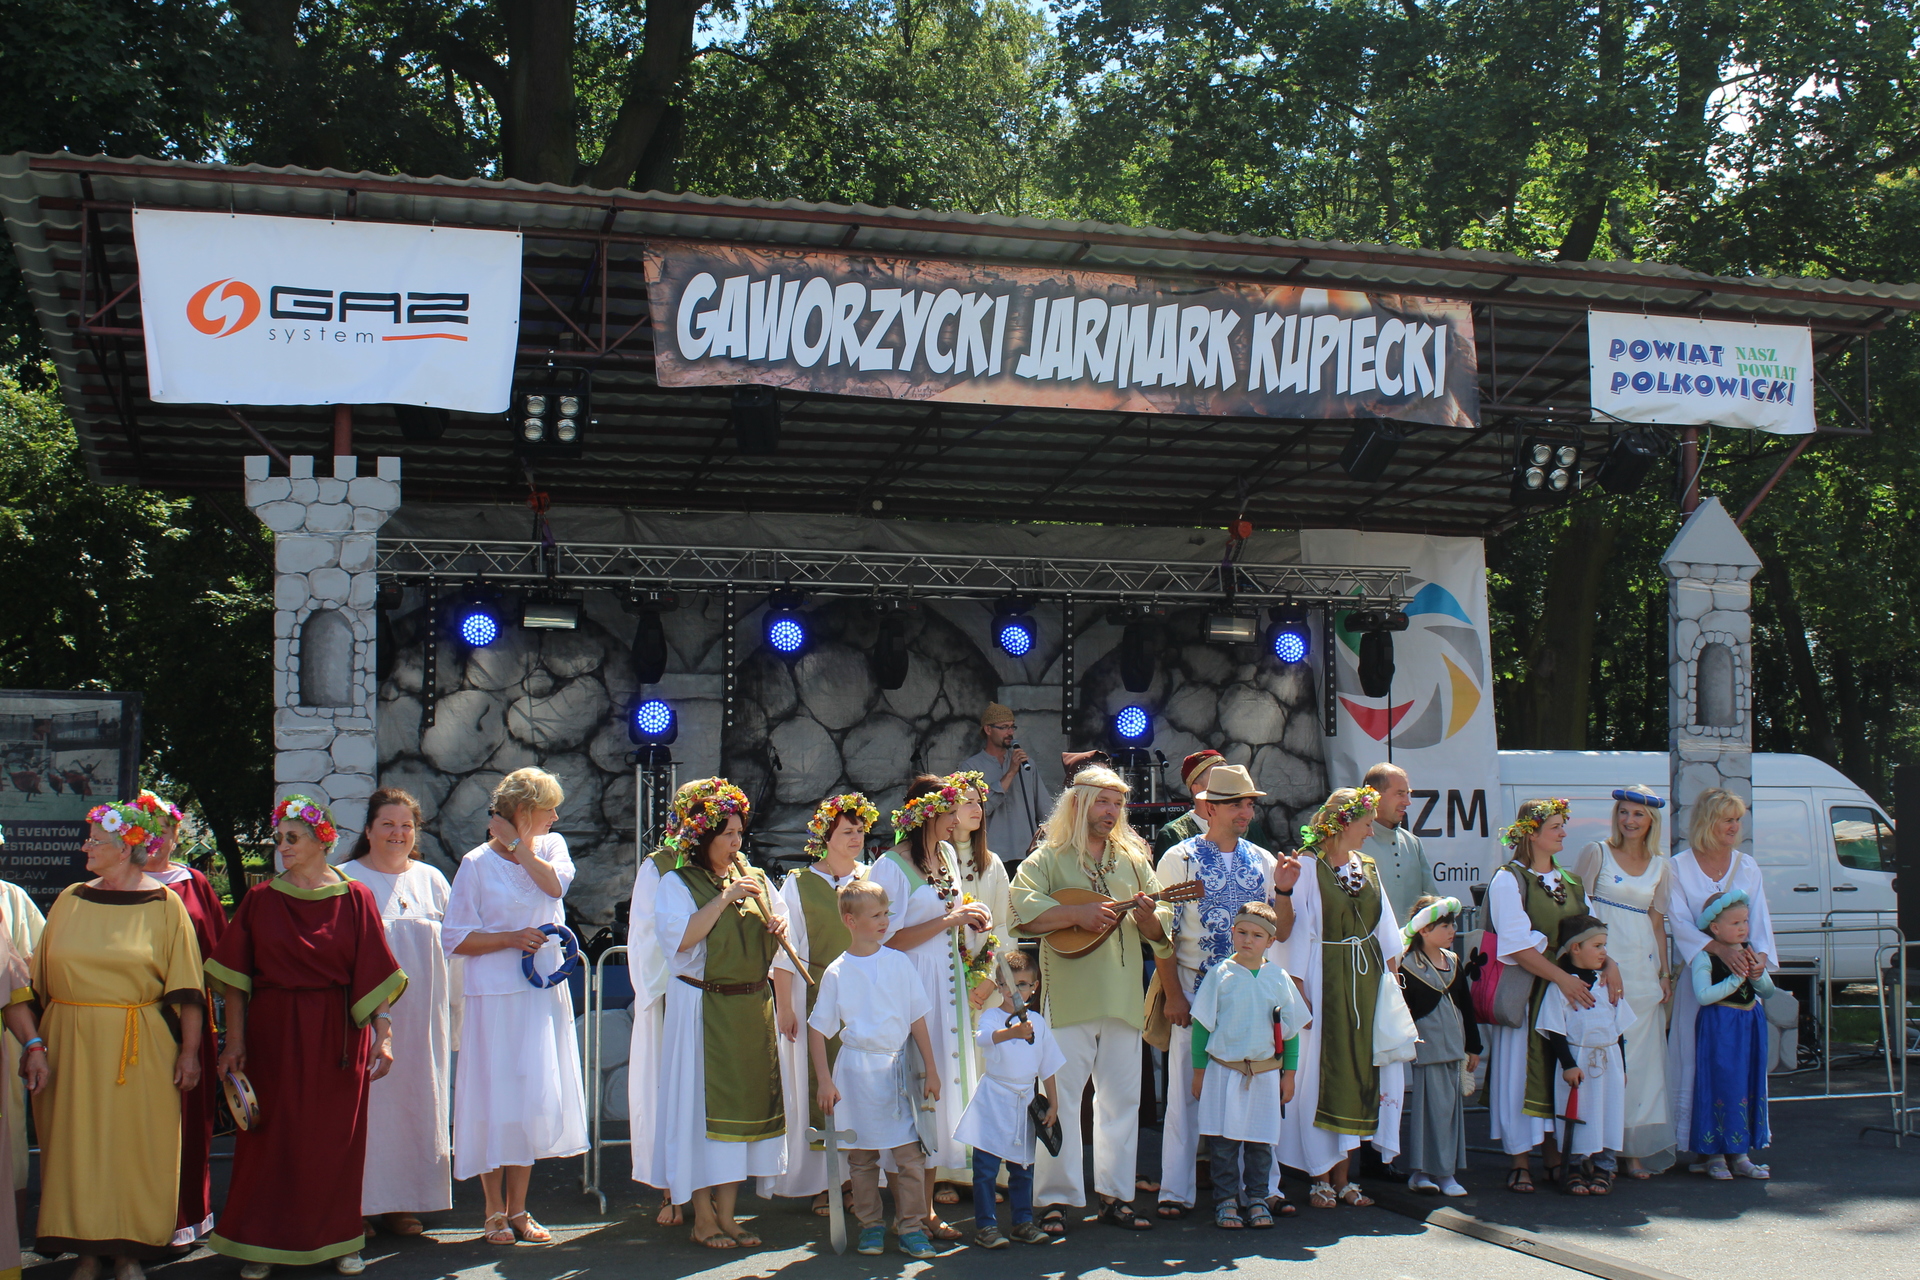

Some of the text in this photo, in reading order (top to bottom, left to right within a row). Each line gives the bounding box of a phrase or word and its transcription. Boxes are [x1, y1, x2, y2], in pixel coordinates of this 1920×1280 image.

[270, 285, 469, 325] GAZ
[269, 326, 375, 344] system
[676, 272, 1447, 399] GAWORZYCKI JARMARK KUPIECKI
[1608, 338, 1725, 367] POWIAT
[1735, 346, 1778, 363] NASZ
[1737, 363, 1797, 381] POWIAT
[1610, 371, 1796, 406] POLKOWICKI
[1402, 789, 1489, 838] ZM
[17, 825, 80, 837] EVENTÓW
[3, 841, 82, 852] ESTRADOWA
[11, 856, 71, 866] DIODOWE
[0, 870, 47, 880] CŁAW
[1433, 861, 1480, 882] Gmin
